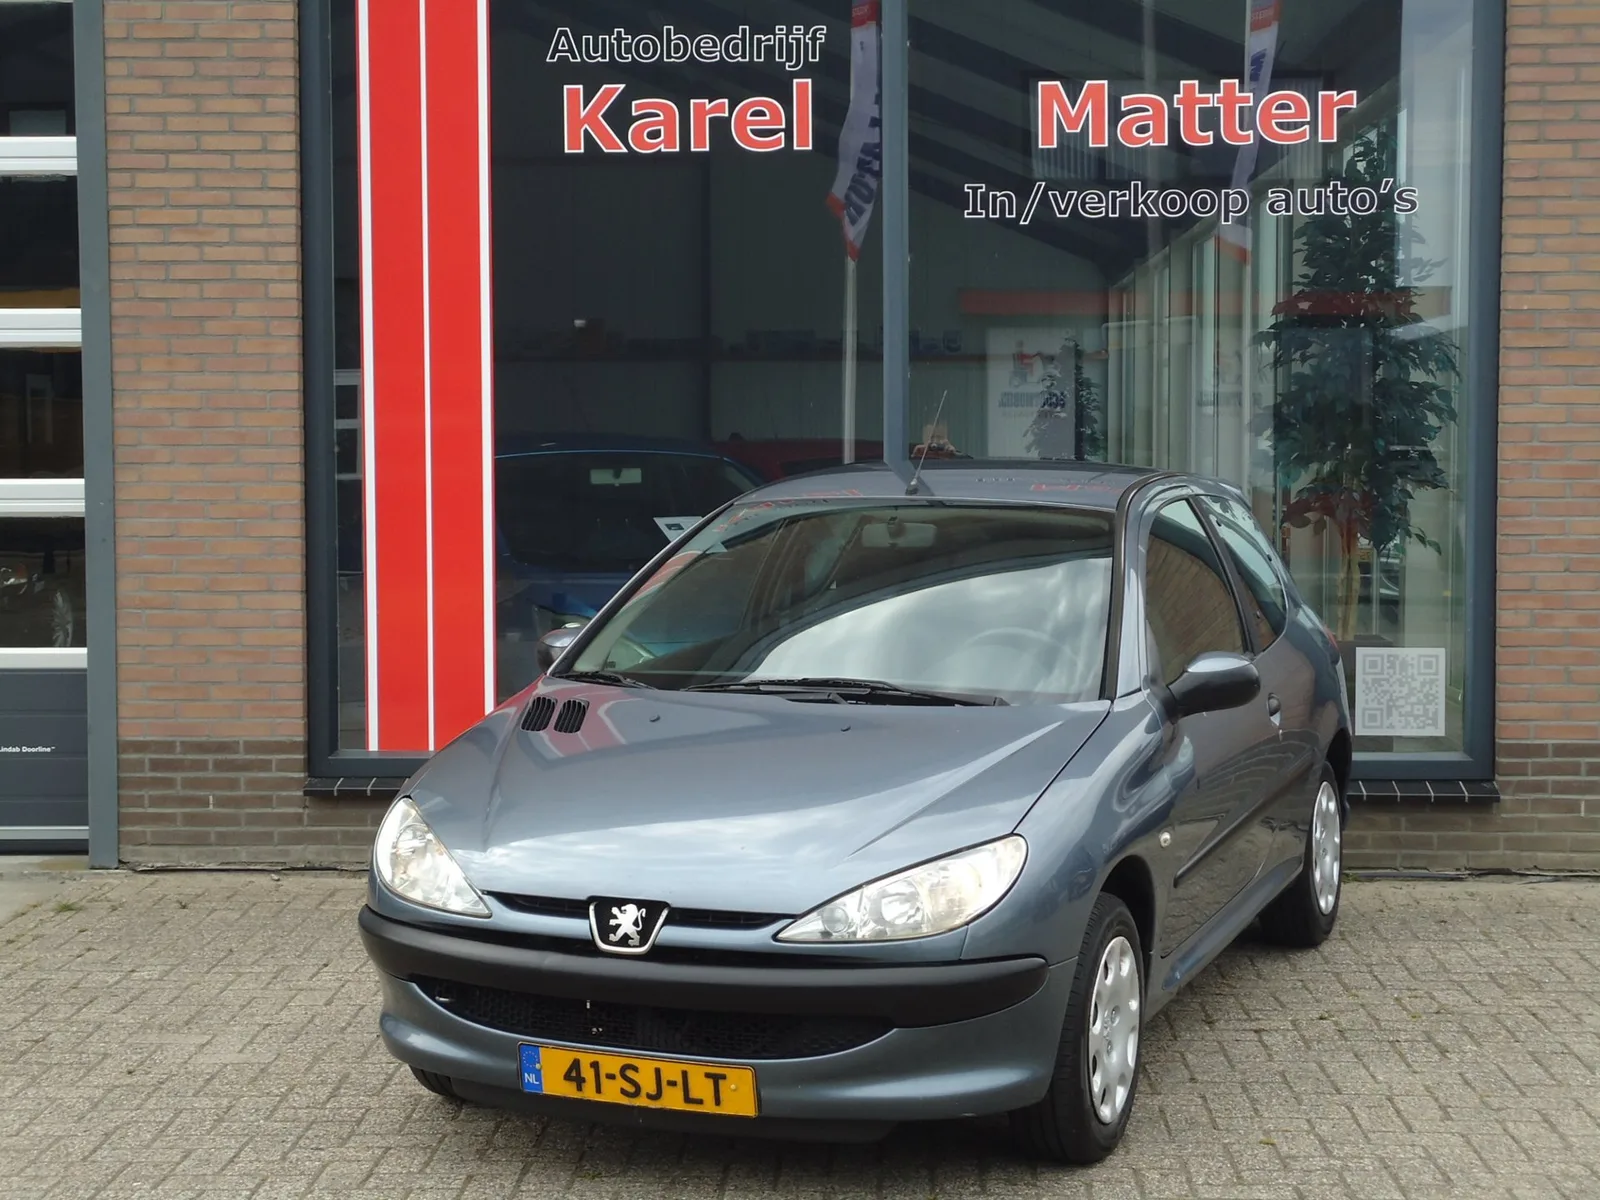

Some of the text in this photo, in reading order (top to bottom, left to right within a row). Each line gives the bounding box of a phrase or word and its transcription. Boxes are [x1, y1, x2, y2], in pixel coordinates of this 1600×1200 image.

[545, 25, 827, 71] Autobedrijf
[563, 78, 1357, 154] Karel Matter
[963, 179, 1420, 225] In/verkoop auto's
[524, 1072, 540, 1085] NL
[562, 1057, 728, 1107] 41-SJ-LT
